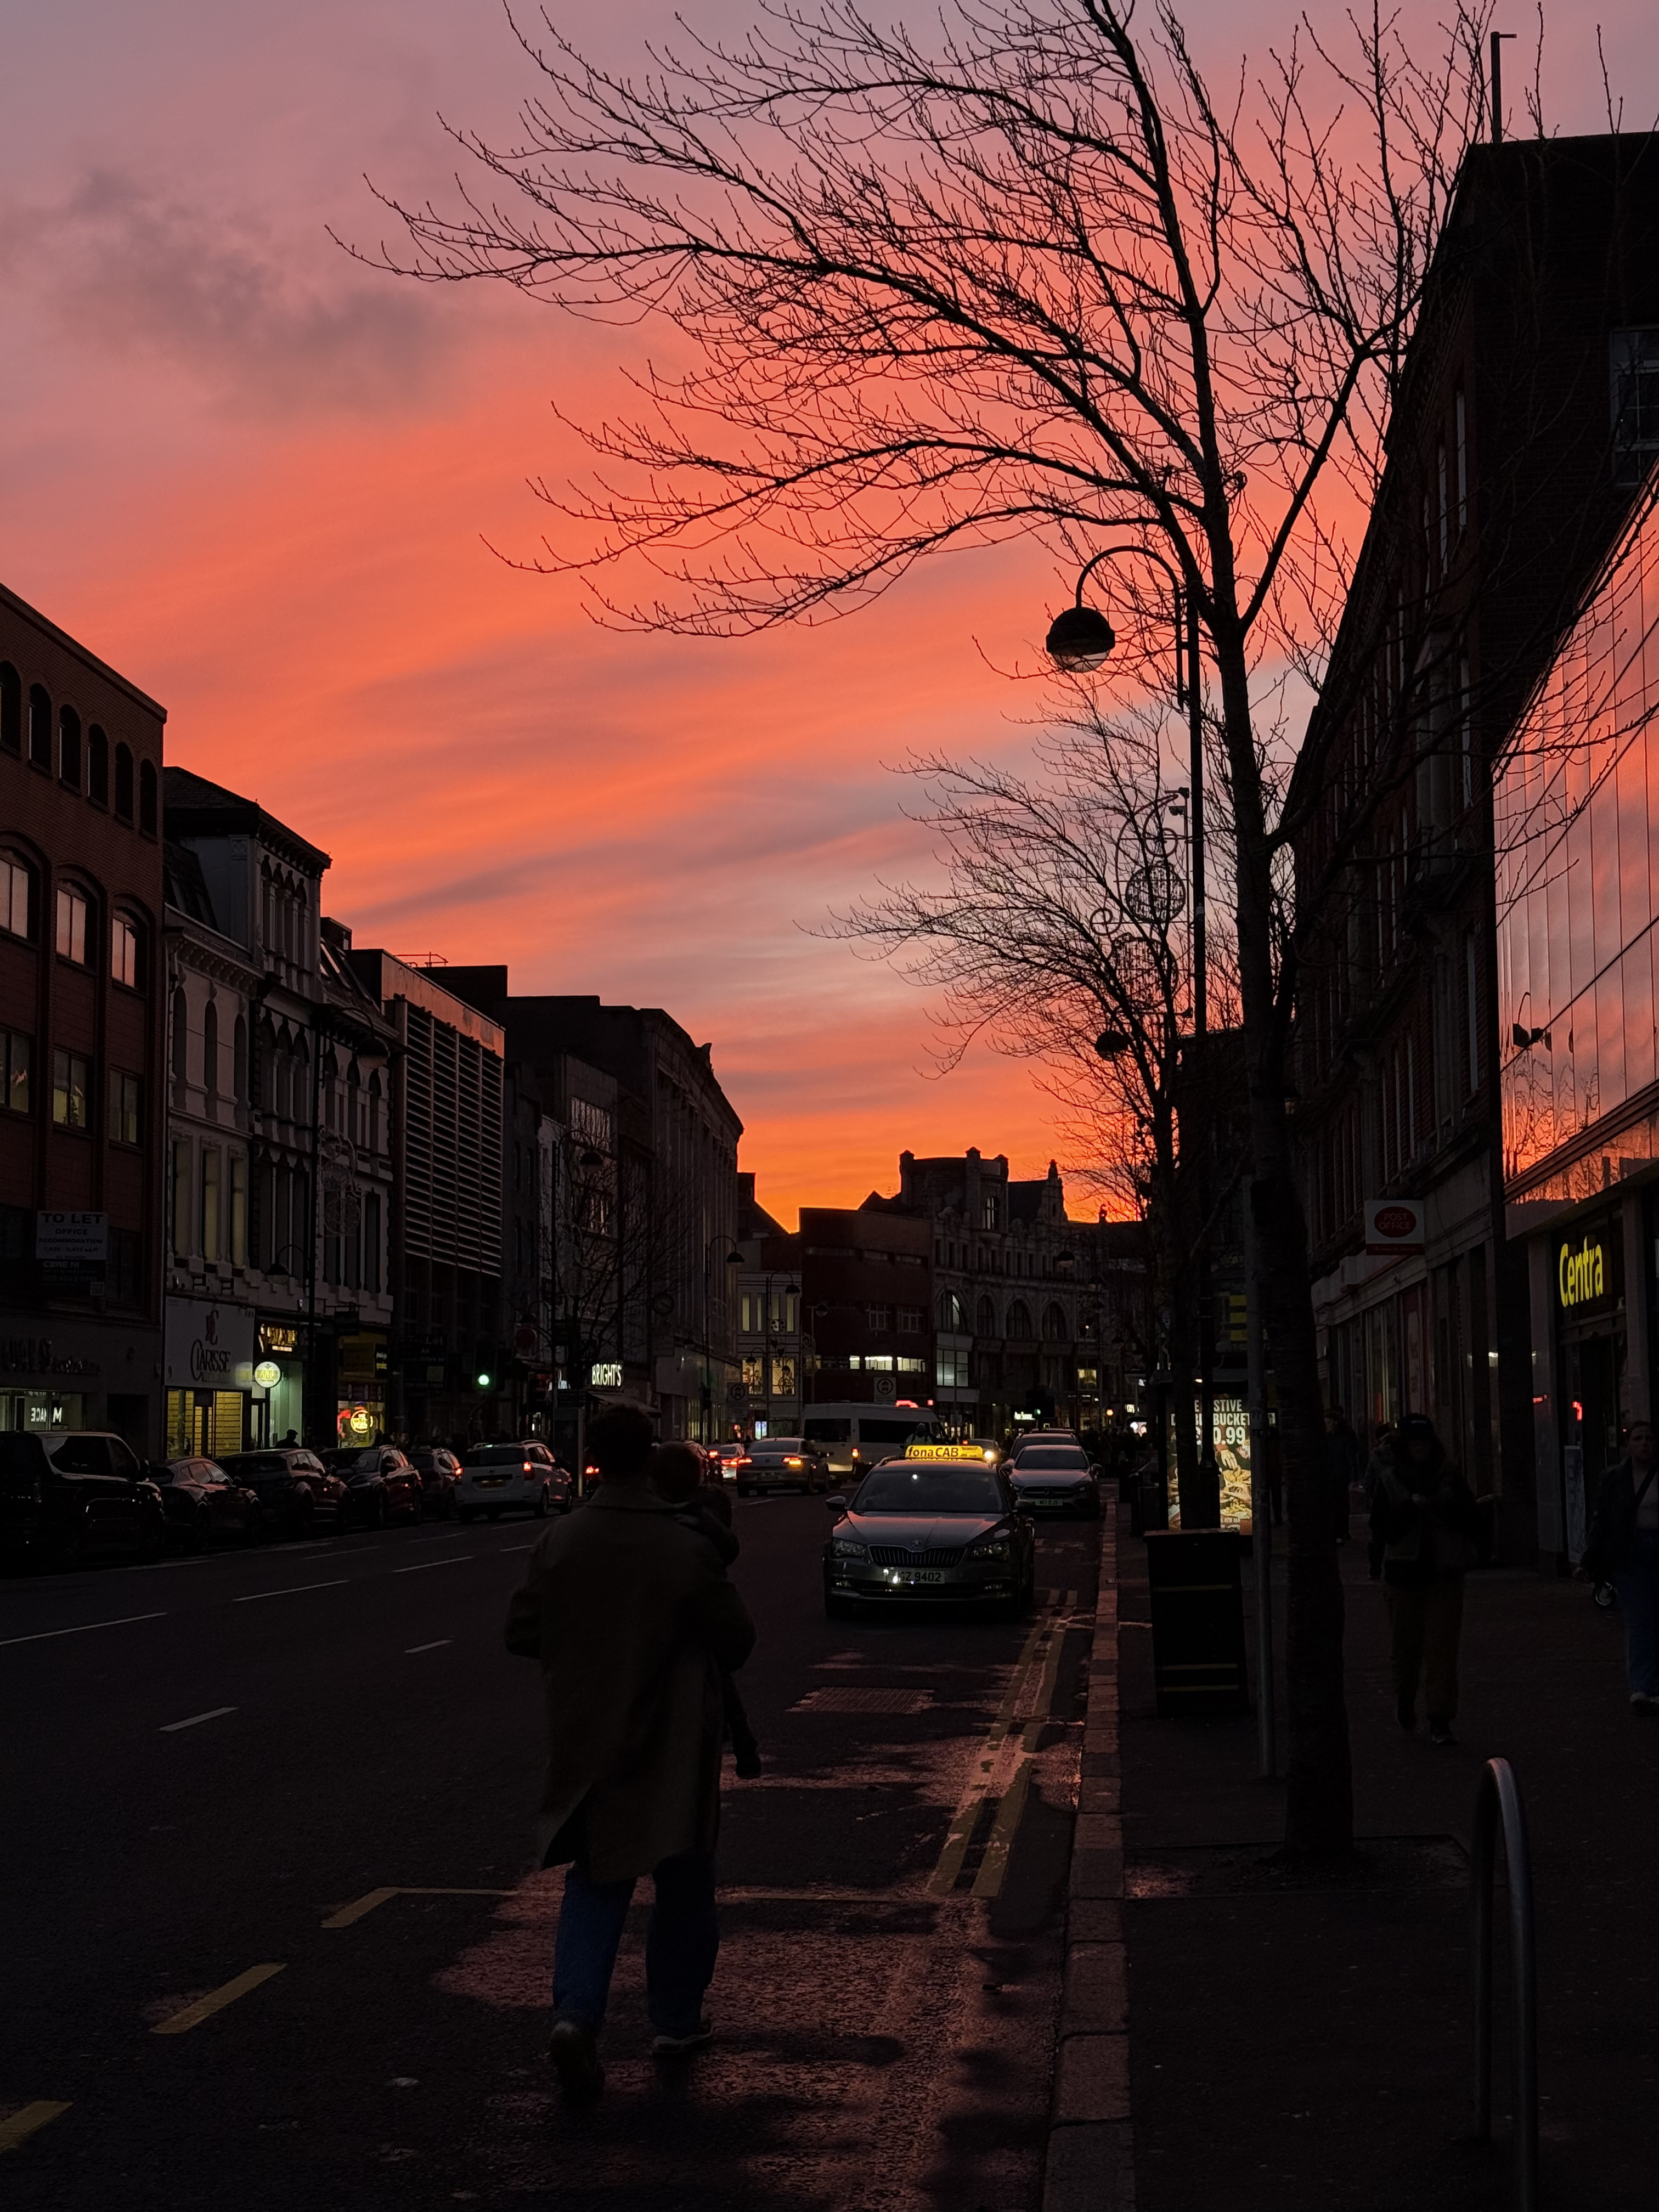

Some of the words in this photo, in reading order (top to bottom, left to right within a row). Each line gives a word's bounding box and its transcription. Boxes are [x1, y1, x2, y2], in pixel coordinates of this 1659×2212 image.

[42, 1213, 65, 1223] TO
[71, 1214, 103, 1224] LET
[1384, 1213, 1408, 1221] POST
[1559, 1235, 1603, 1307] Centra
[191, 1339, 230, 1381] CLARISSE
[592, 1363, 622, 1386] BRIGHT'S
[1213, 1413, 1250, 1426] BUCKET
[915, 1572, 941, 1582] 9402
